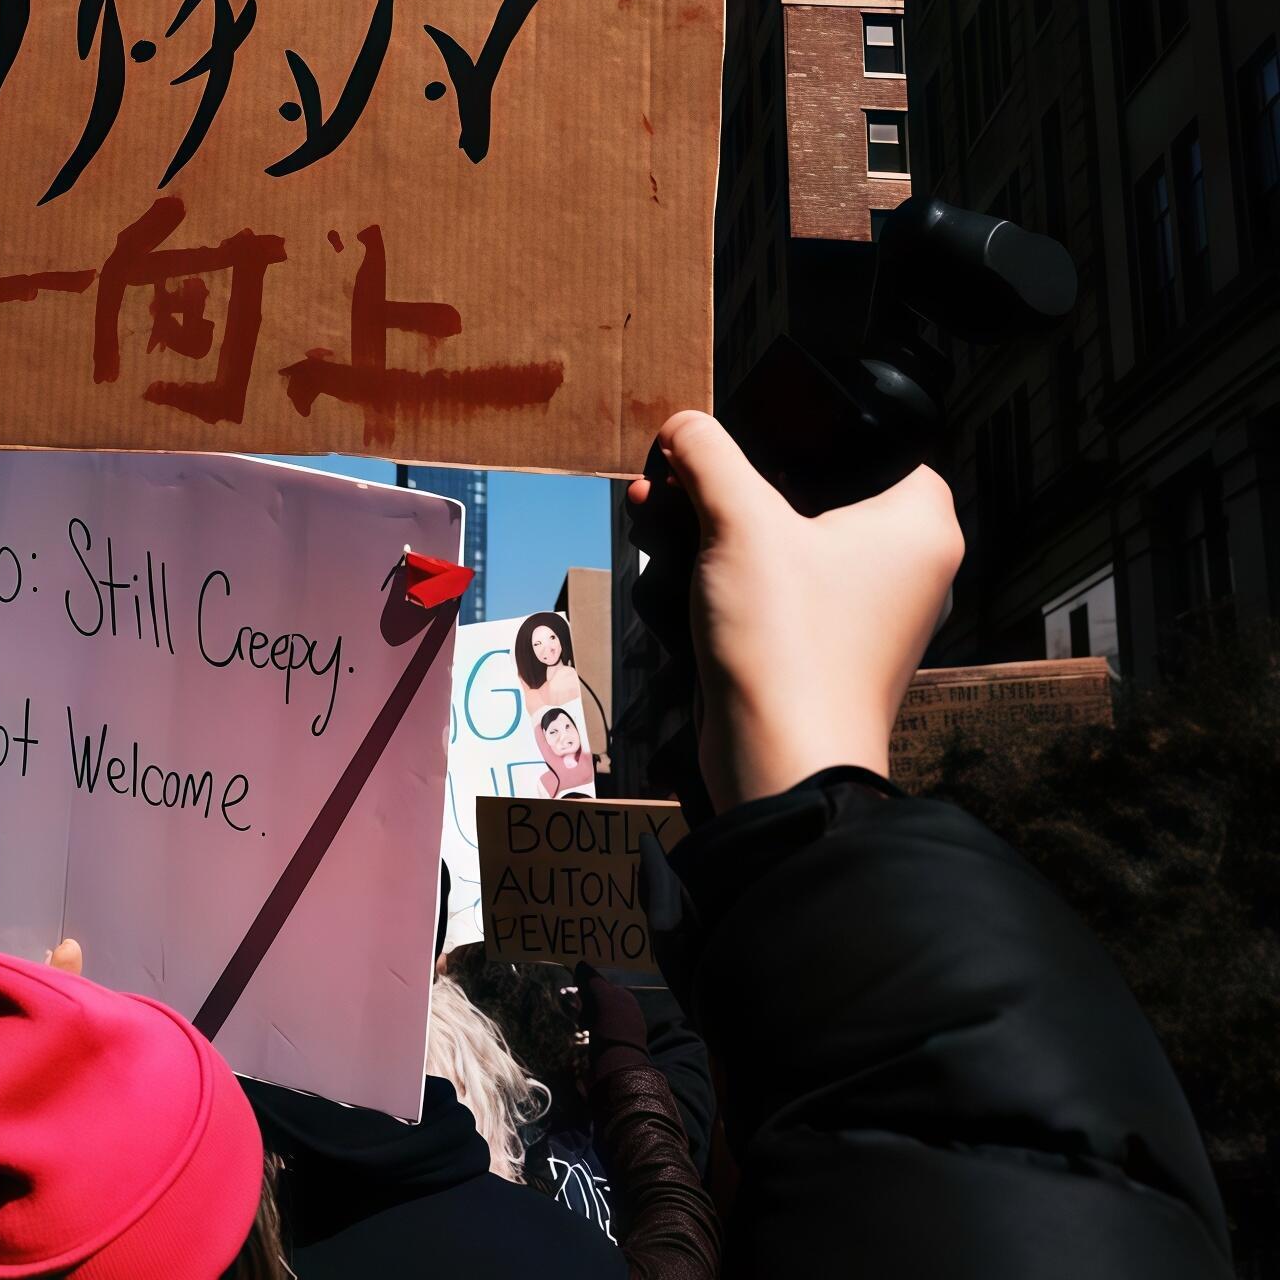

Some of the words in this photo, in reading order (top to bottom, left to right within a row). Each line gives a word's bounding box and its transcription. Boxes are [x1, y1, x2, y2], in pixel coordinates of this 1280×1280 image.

[65, 517, 175, 655] Still
[197, 570, 355, 737] Creepy.
[66, 705, 266, 837] Welcome.
[492, 863, 642, 910] AUTON
